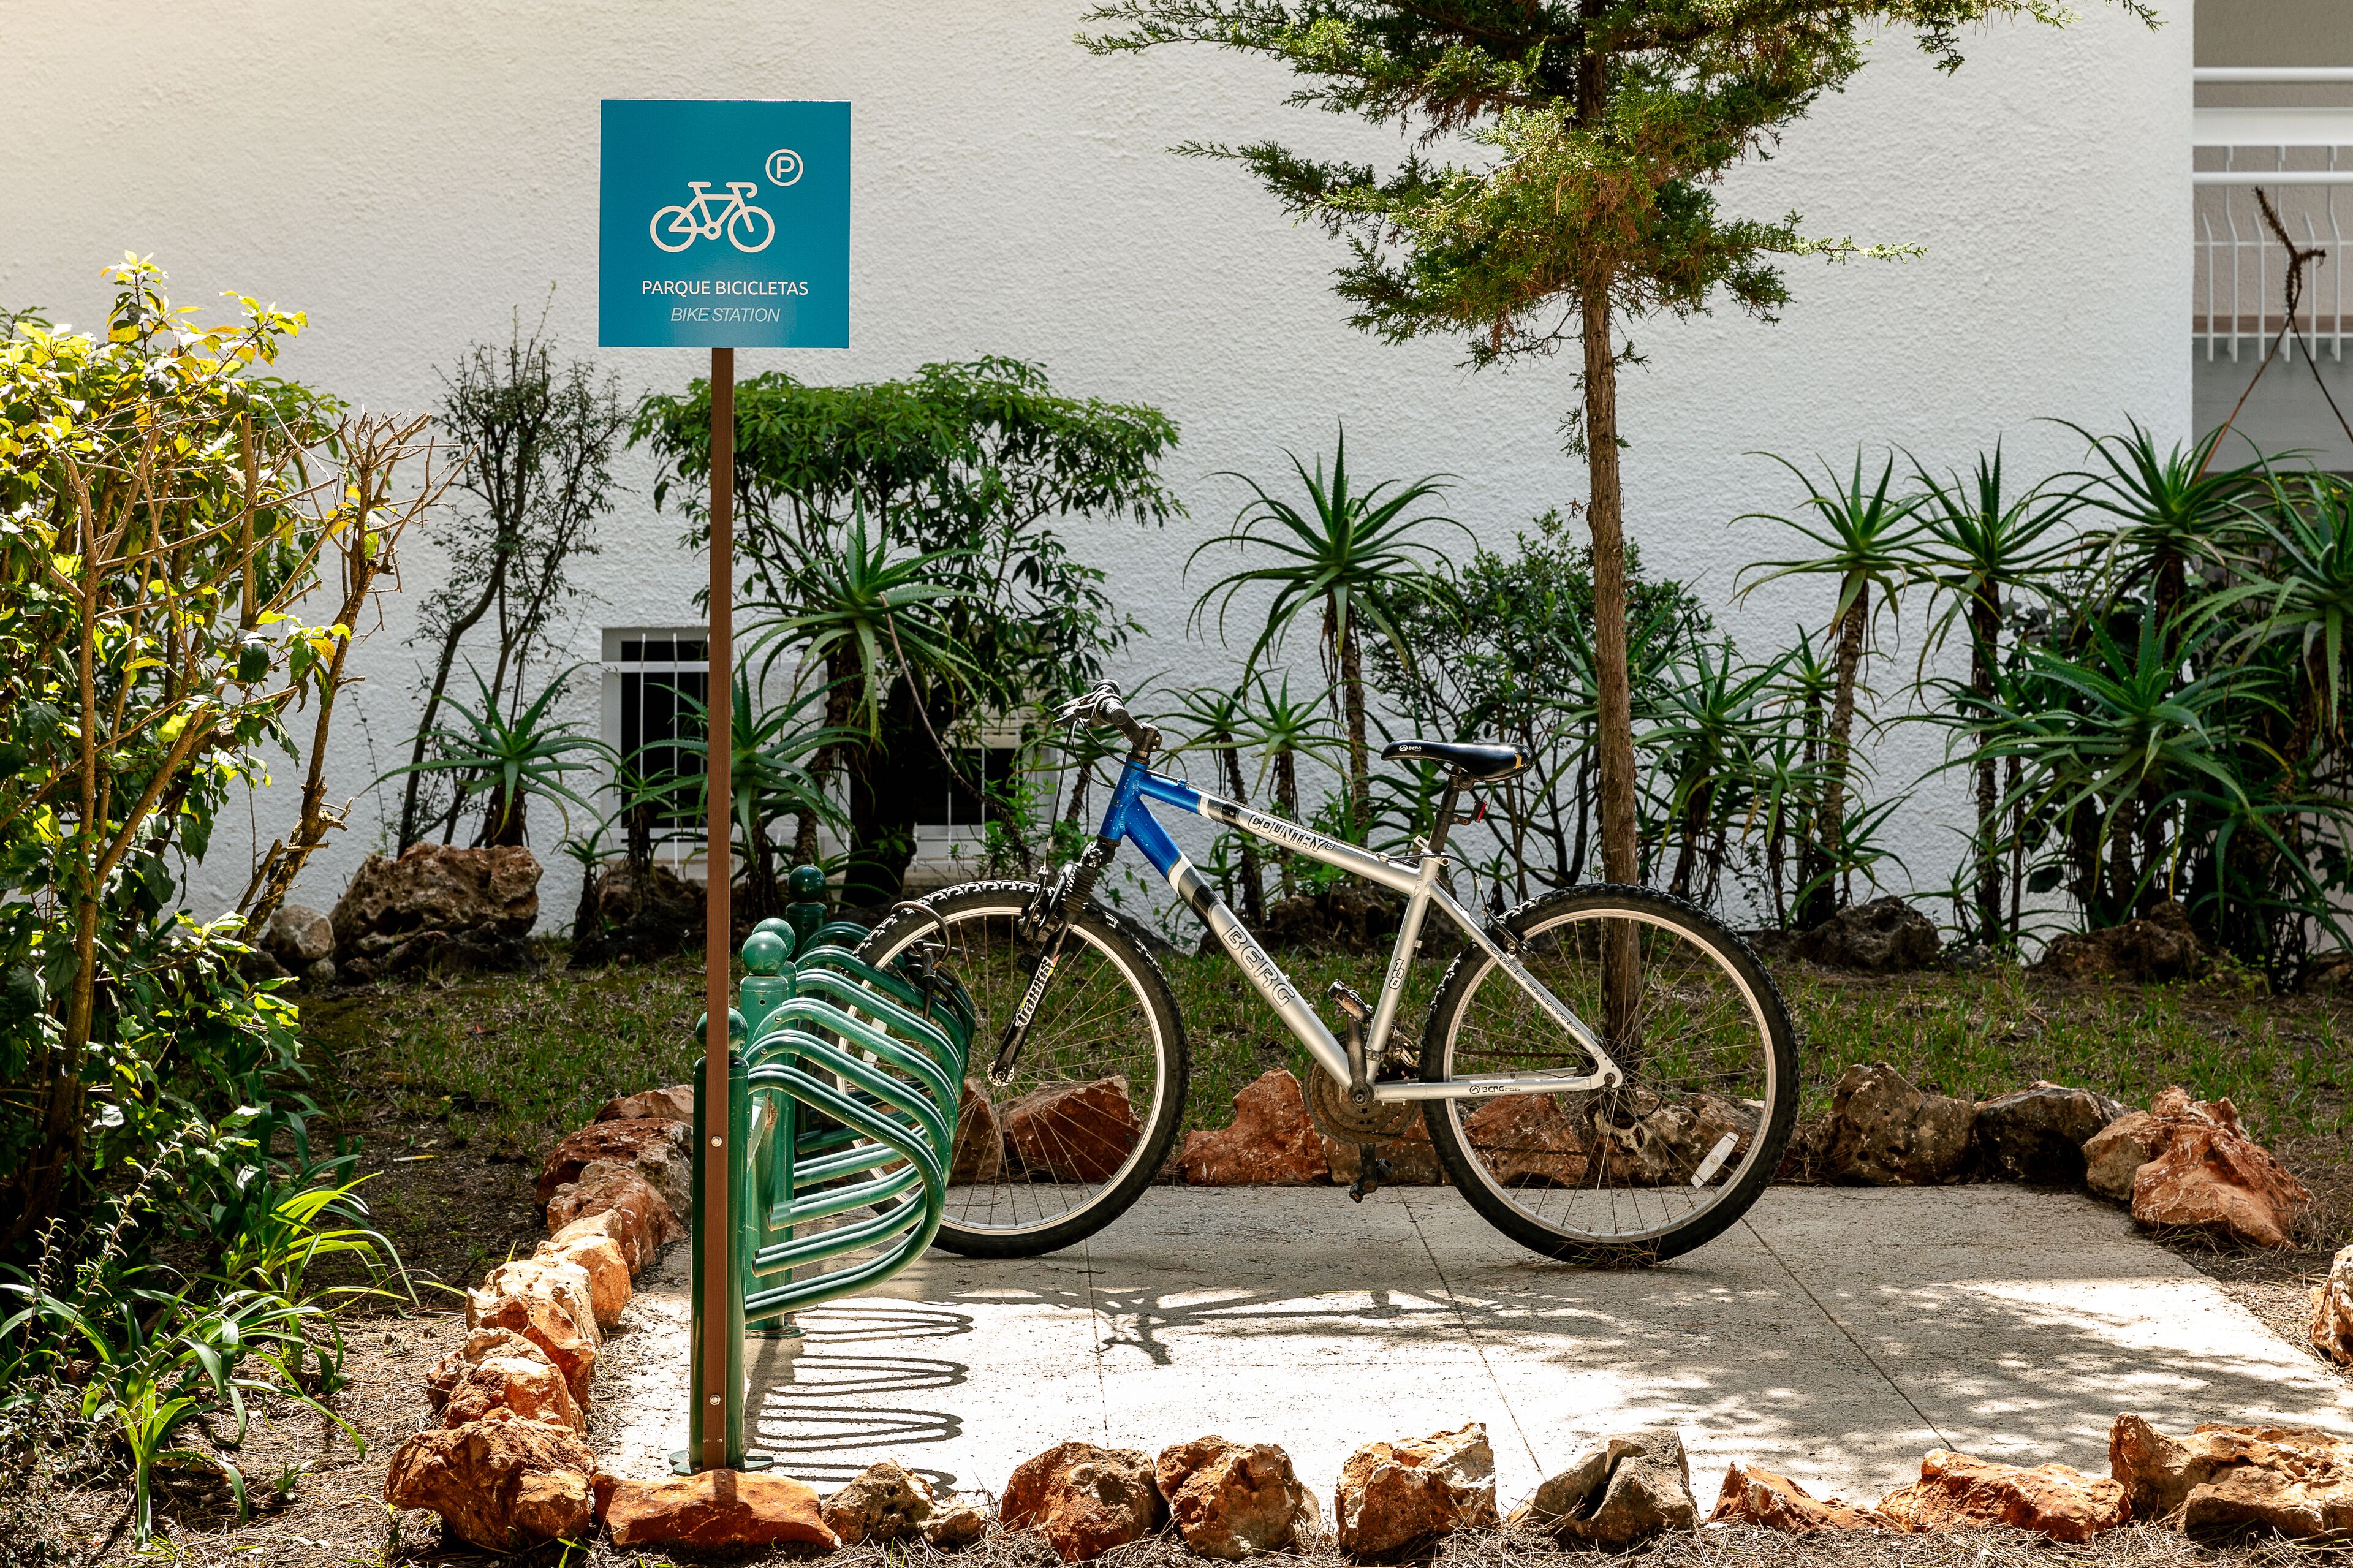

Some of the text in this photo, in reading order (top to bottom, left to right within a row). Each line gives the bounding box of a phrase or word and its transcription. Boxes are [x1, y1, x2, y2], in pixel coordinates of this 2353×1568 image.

[776, 156, 795, 179] P
[642, 280, 809, 298] PARQUE BICICLETAS
[670, 307, 781, 322] BIKE STATION
[1222, 924, 1295, 1007] BERG
[1486, 942, 1580, 1032] CROSS COUNTRY
